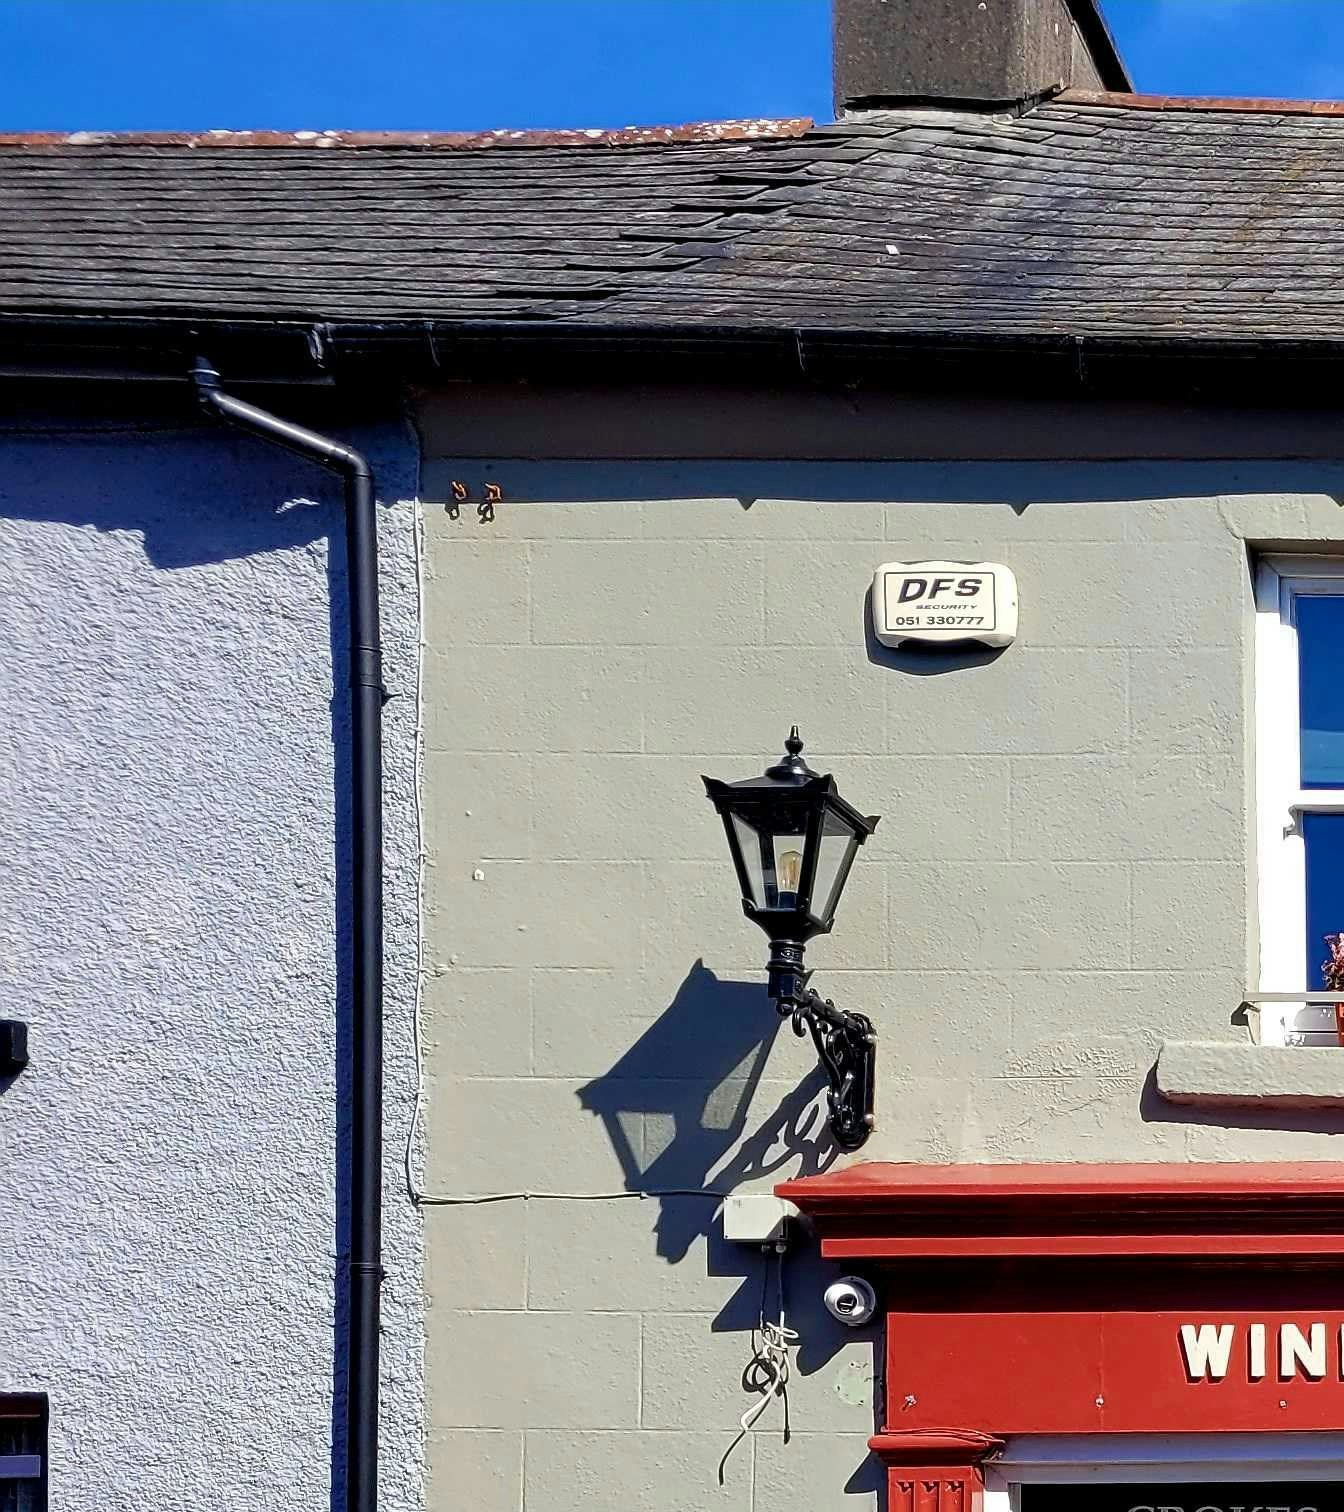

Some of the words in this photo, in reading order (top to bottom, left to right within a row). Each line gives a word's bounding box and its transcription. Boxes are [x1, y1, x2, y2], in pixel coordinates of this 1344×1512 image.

[897, 578, 982, 603] DFS
[896, 616, 920, 625] 051
[926, 616, 984, 625] 330777
